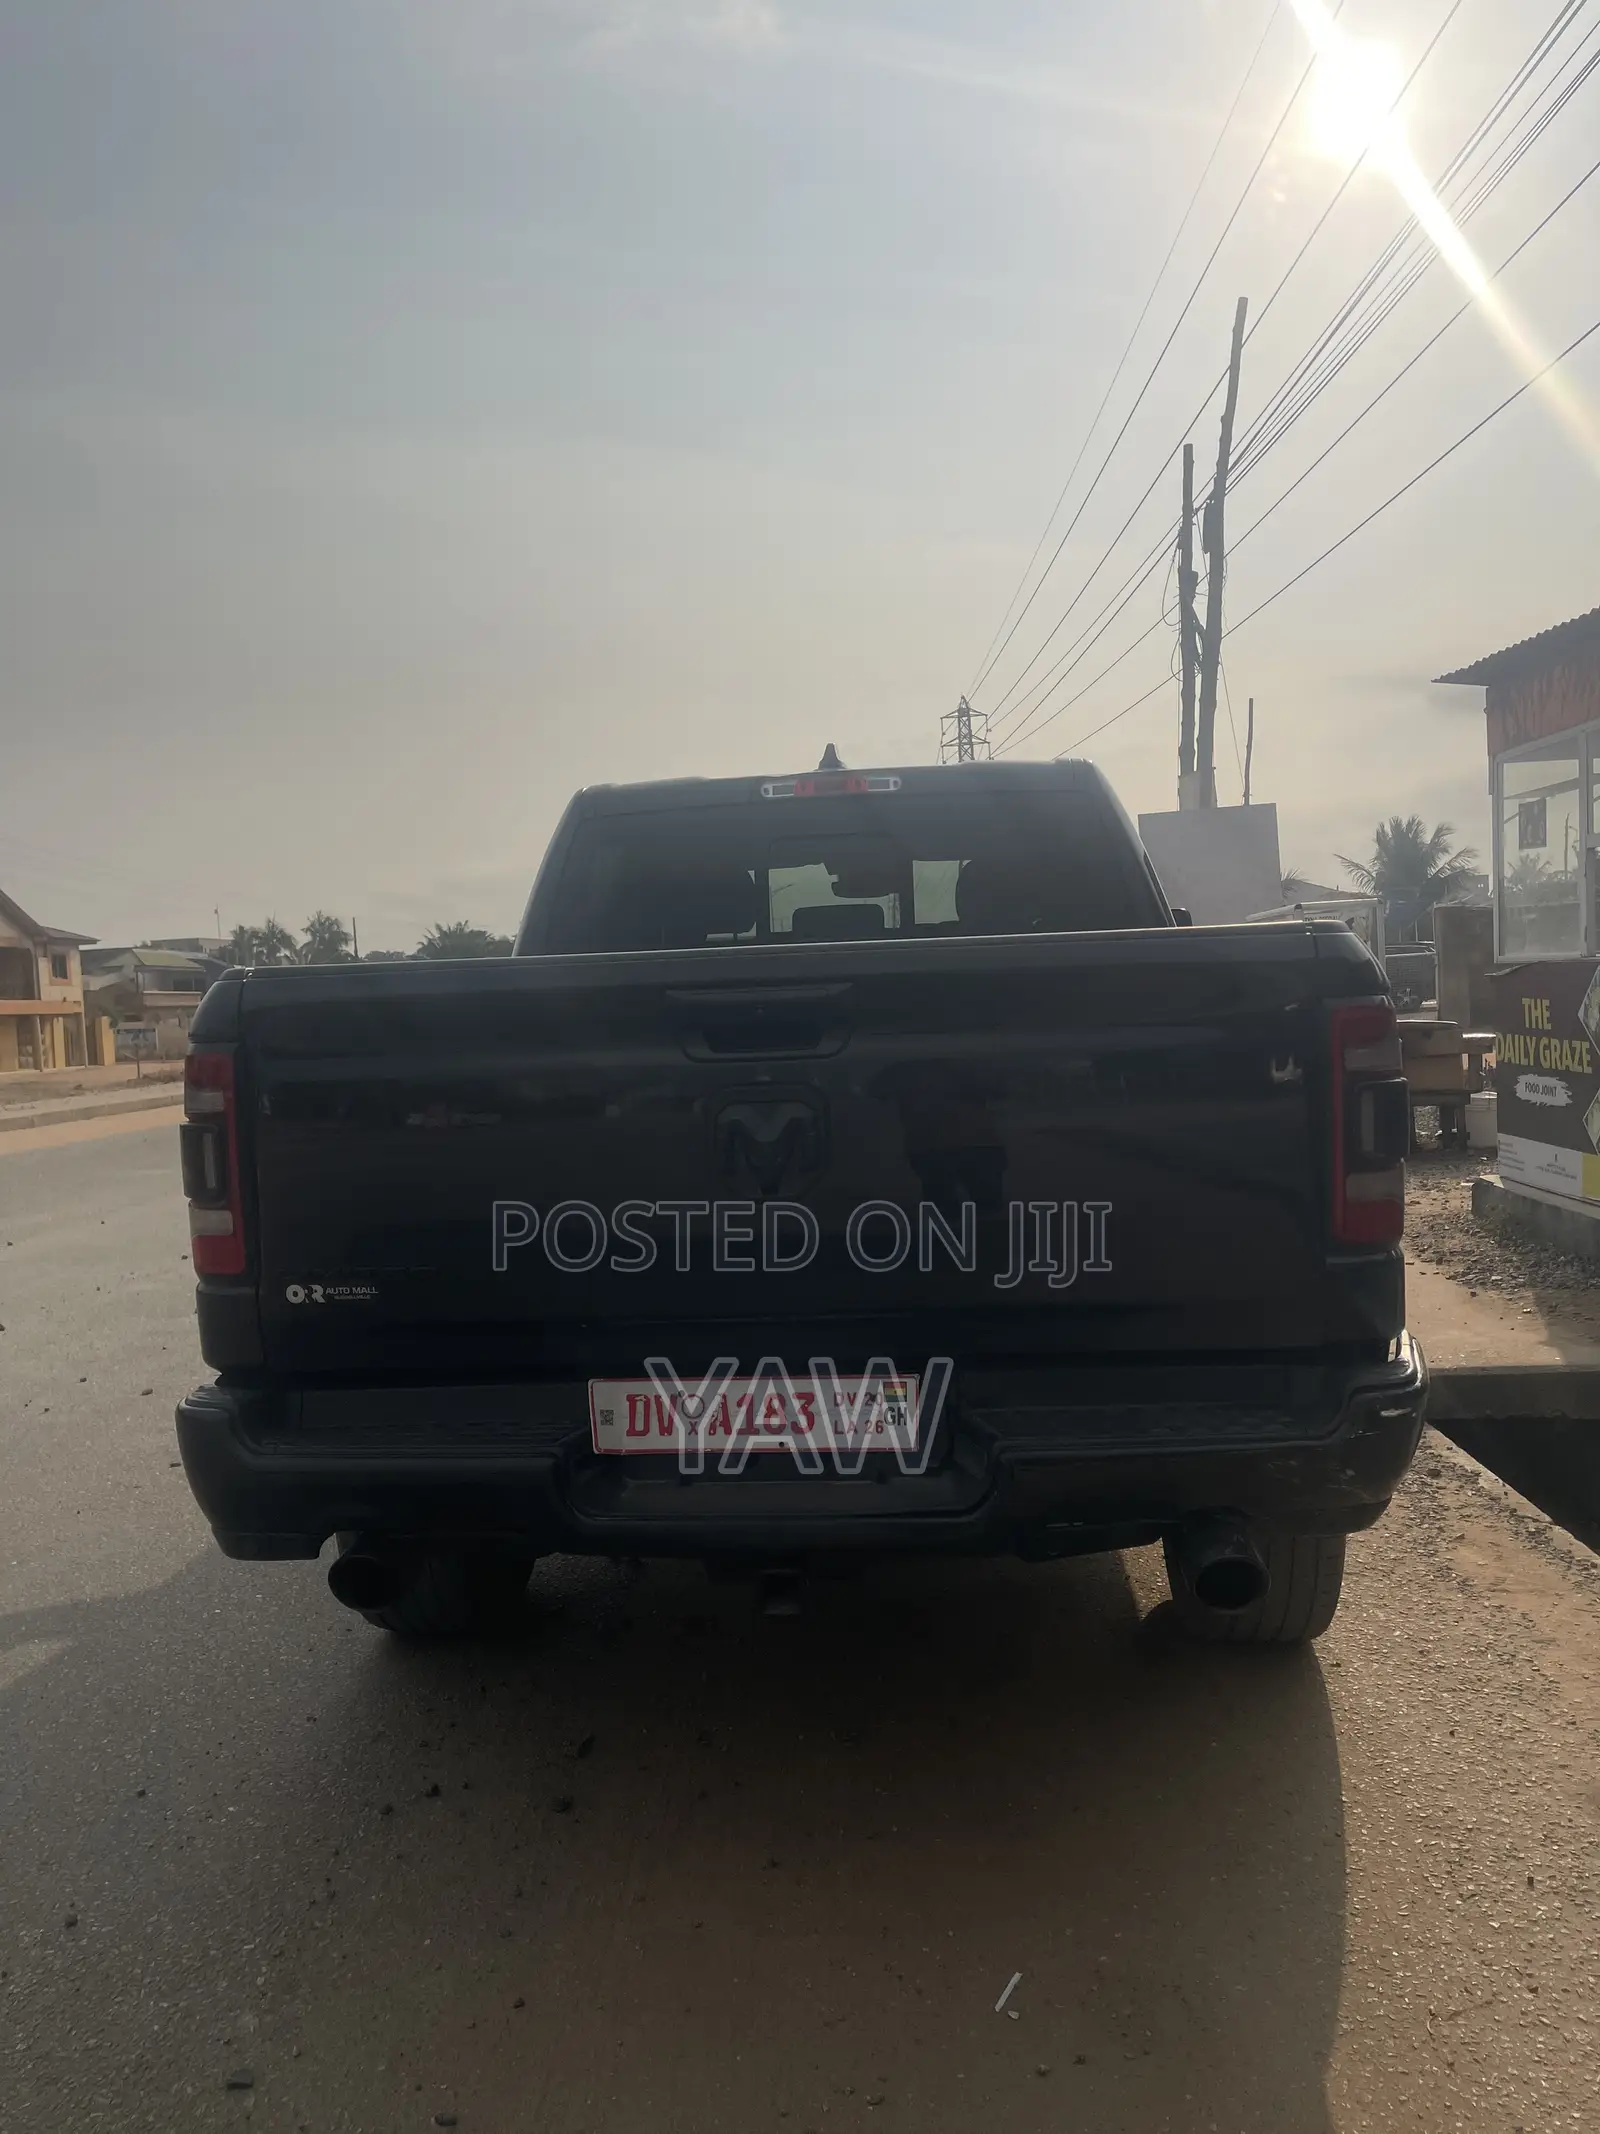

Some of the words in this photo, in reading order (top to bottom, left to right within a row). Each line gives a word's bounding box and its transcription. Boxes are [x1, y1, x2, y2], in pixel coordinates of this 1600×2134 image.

[1521, 997, 1552, 1030] THE
[1496, 1031, 1537, 1067] DAILY
[1539, 1039, 1593, 1074] GRAZE
[1524, 1081, 1541, 1096] FOOD
[1540, 1083, 1558, 1098] JOINT
[326, 1286, 350, 1295] AUTO
[351, 1286, 379, 1295] MALL
[883, 1406, 908, 1426] GH
